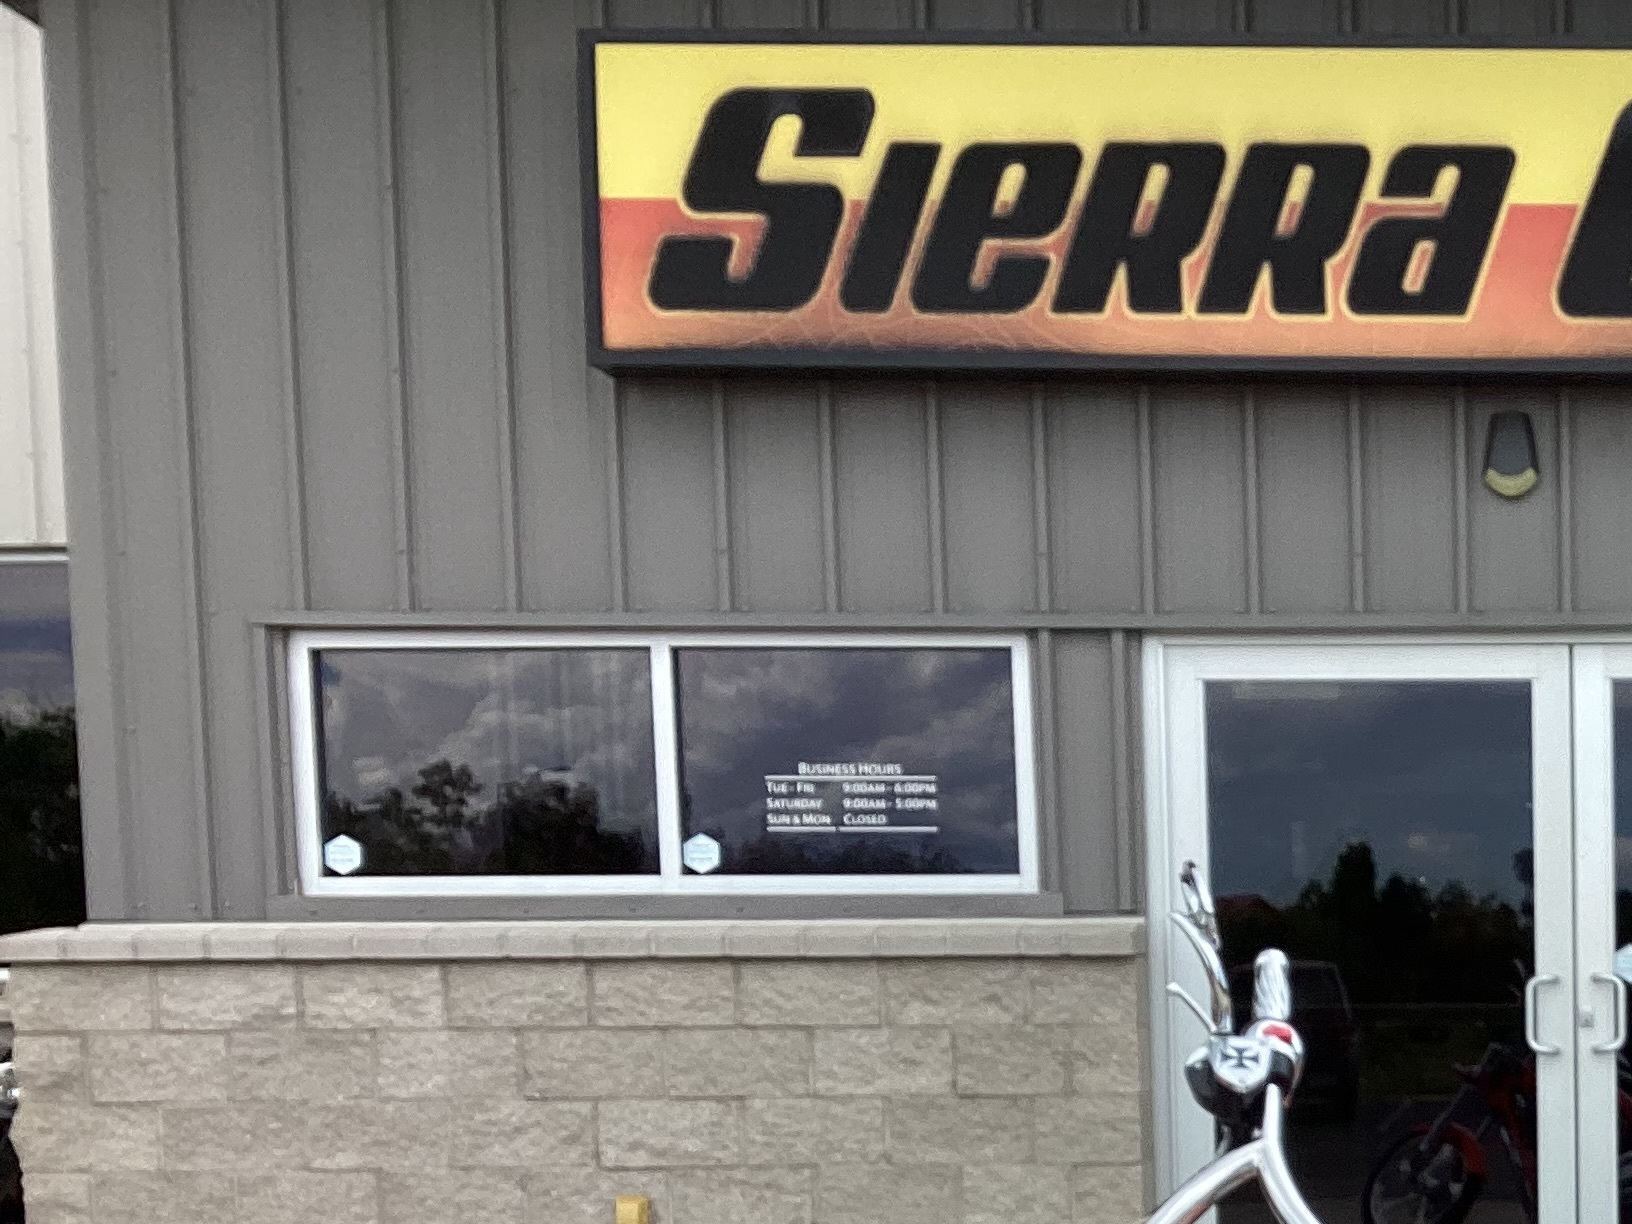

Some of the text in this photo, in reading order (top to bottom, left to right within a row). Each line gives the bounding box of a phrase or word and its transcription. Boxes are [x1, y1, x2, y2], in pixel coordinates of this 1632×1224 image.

[798, 762, 902, 775] BUSINESS HOURS
[796, 781, 816, 794] FRI
[766, 797, 824, 809] SATURDAY
[843, 813, 887, 825] CLOSED
